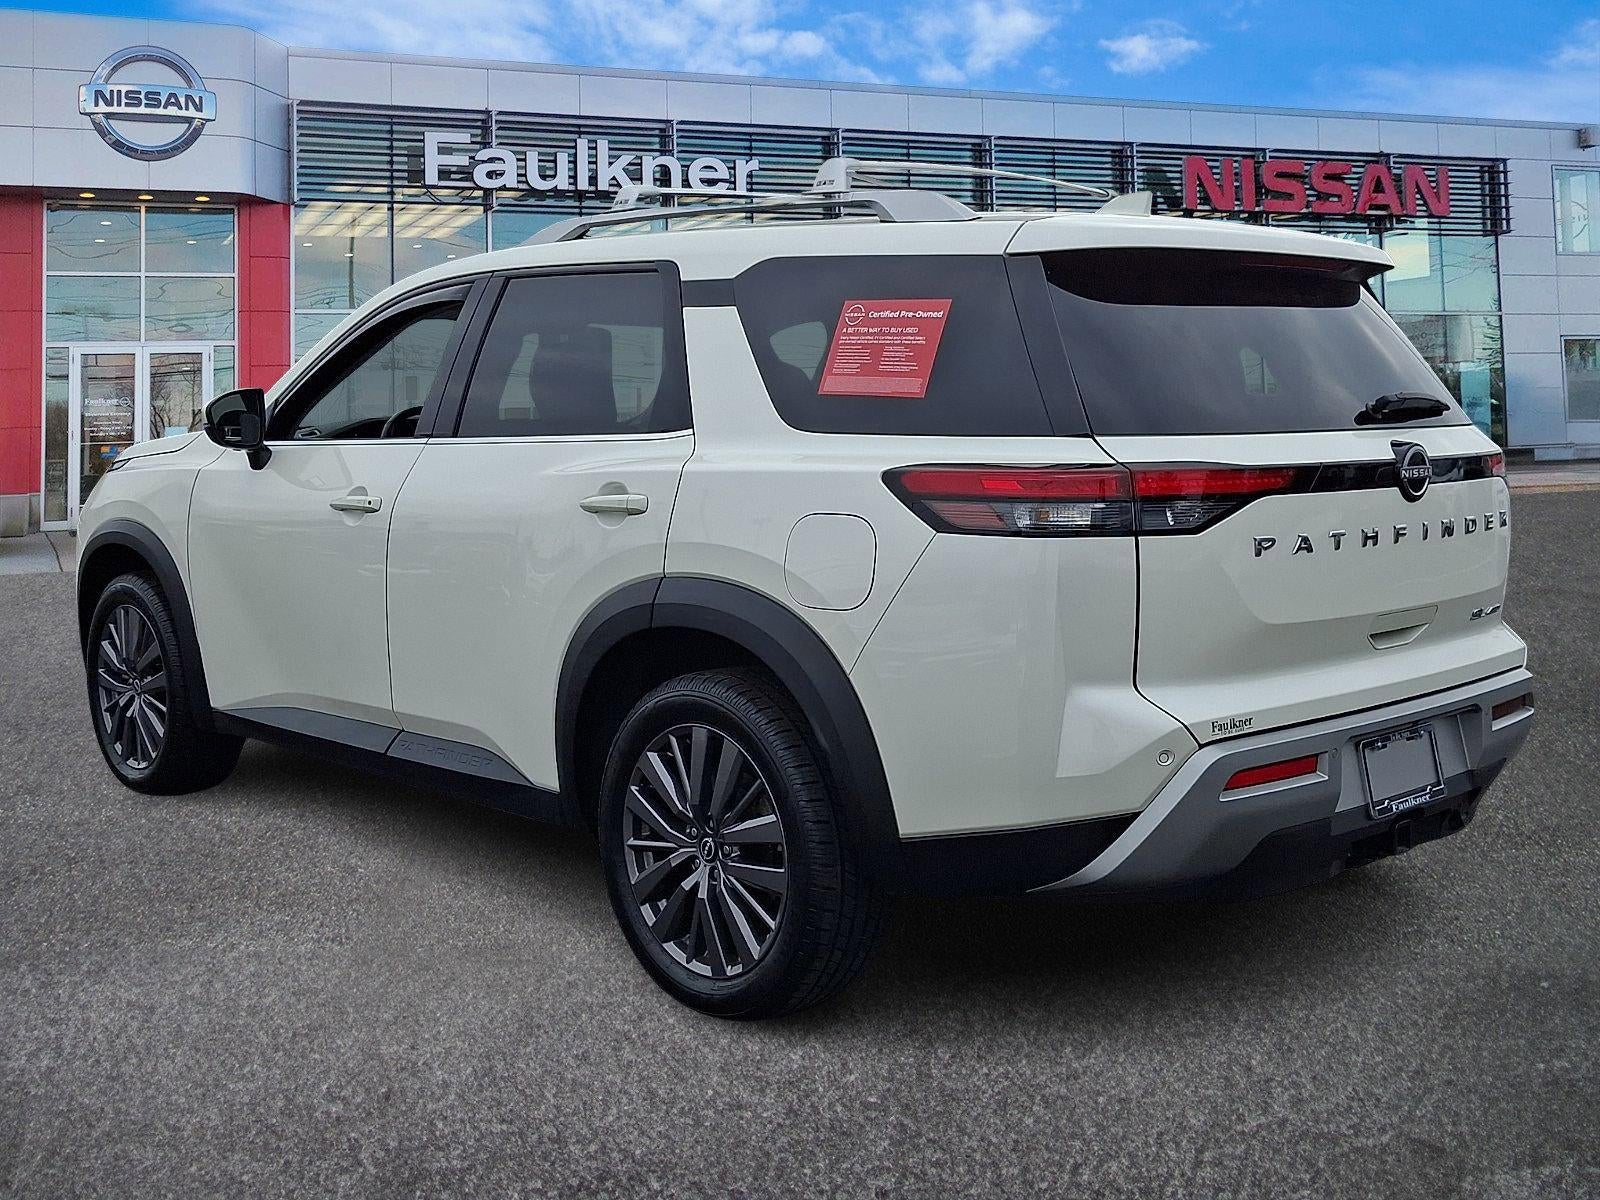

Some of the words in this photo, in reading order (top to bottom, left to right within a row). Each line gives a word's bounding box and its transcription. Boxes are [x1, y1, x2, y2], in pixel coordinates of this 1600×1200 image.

[93, 89, 204, 113] NISSAN
[423, 131, 760, 192] Faulkner
[1182, 155, 1450, 216] NISSAN
[868, 310, 900, 318] Certified
[900, 310, 944, 318] Pre-Owned
[1253, 510, 1508, 558] PATHFINDER
[1211, 716, 1254, 734] Faulkner
[1391, 793, 1431, 813] Faulkner
